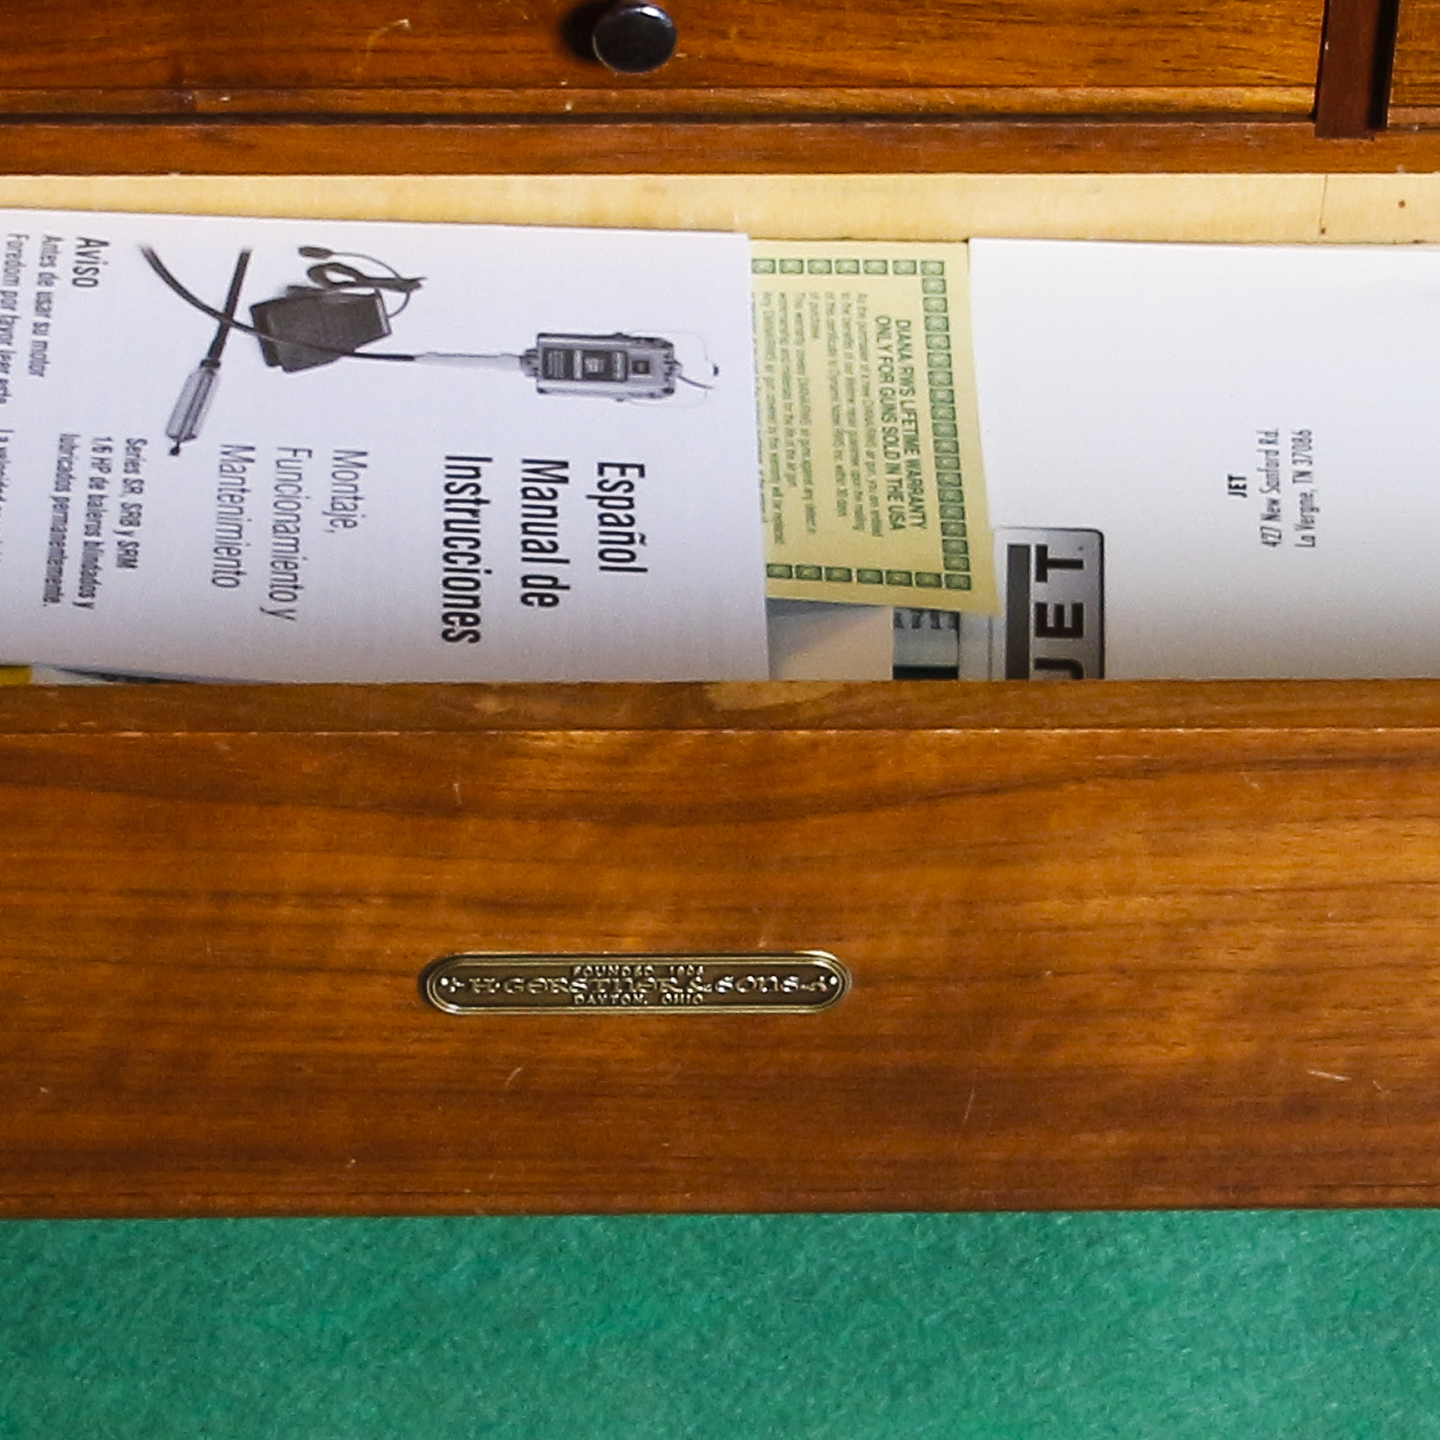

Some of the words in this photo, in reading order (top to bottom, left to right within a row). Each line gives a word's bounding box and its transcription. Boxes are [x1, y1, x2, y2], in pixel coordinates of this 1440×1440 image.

[3, 234, 29, 286] Foredom
[39, 235, 63, 268] Antes
[72, 237, 109, 288] Aviso
[37, 272, 59, 286] de
[35, 291, 52, 317] usar
[32, 322, 50, 335] su
[28, 340, 49, 377] motor
[91, 457, 111, 474] HP
[124, 438, 148, 474] Series
[88, 477, 109, 490] de
[323, 449, 369, 534] Montaje,
[1227, 474, 1247, 498] JET
[84, 494, 108, 537] baleros
[212, 444, 255, 588] Mantenimiento
[267, 447, 311, 602] Funcionamiento
[520, 459, 569, 564] Manual
[586, 461, 648, 573] Español
[117, 540, 139, 569] SRM
[440, 456, 493, 644] Instrucciones
[78, 541, 104, 598] blindados
[520, 575, 571, 607] de
[260, 608, 298, 620] y
[1034, 544, 1084, 679] JET
